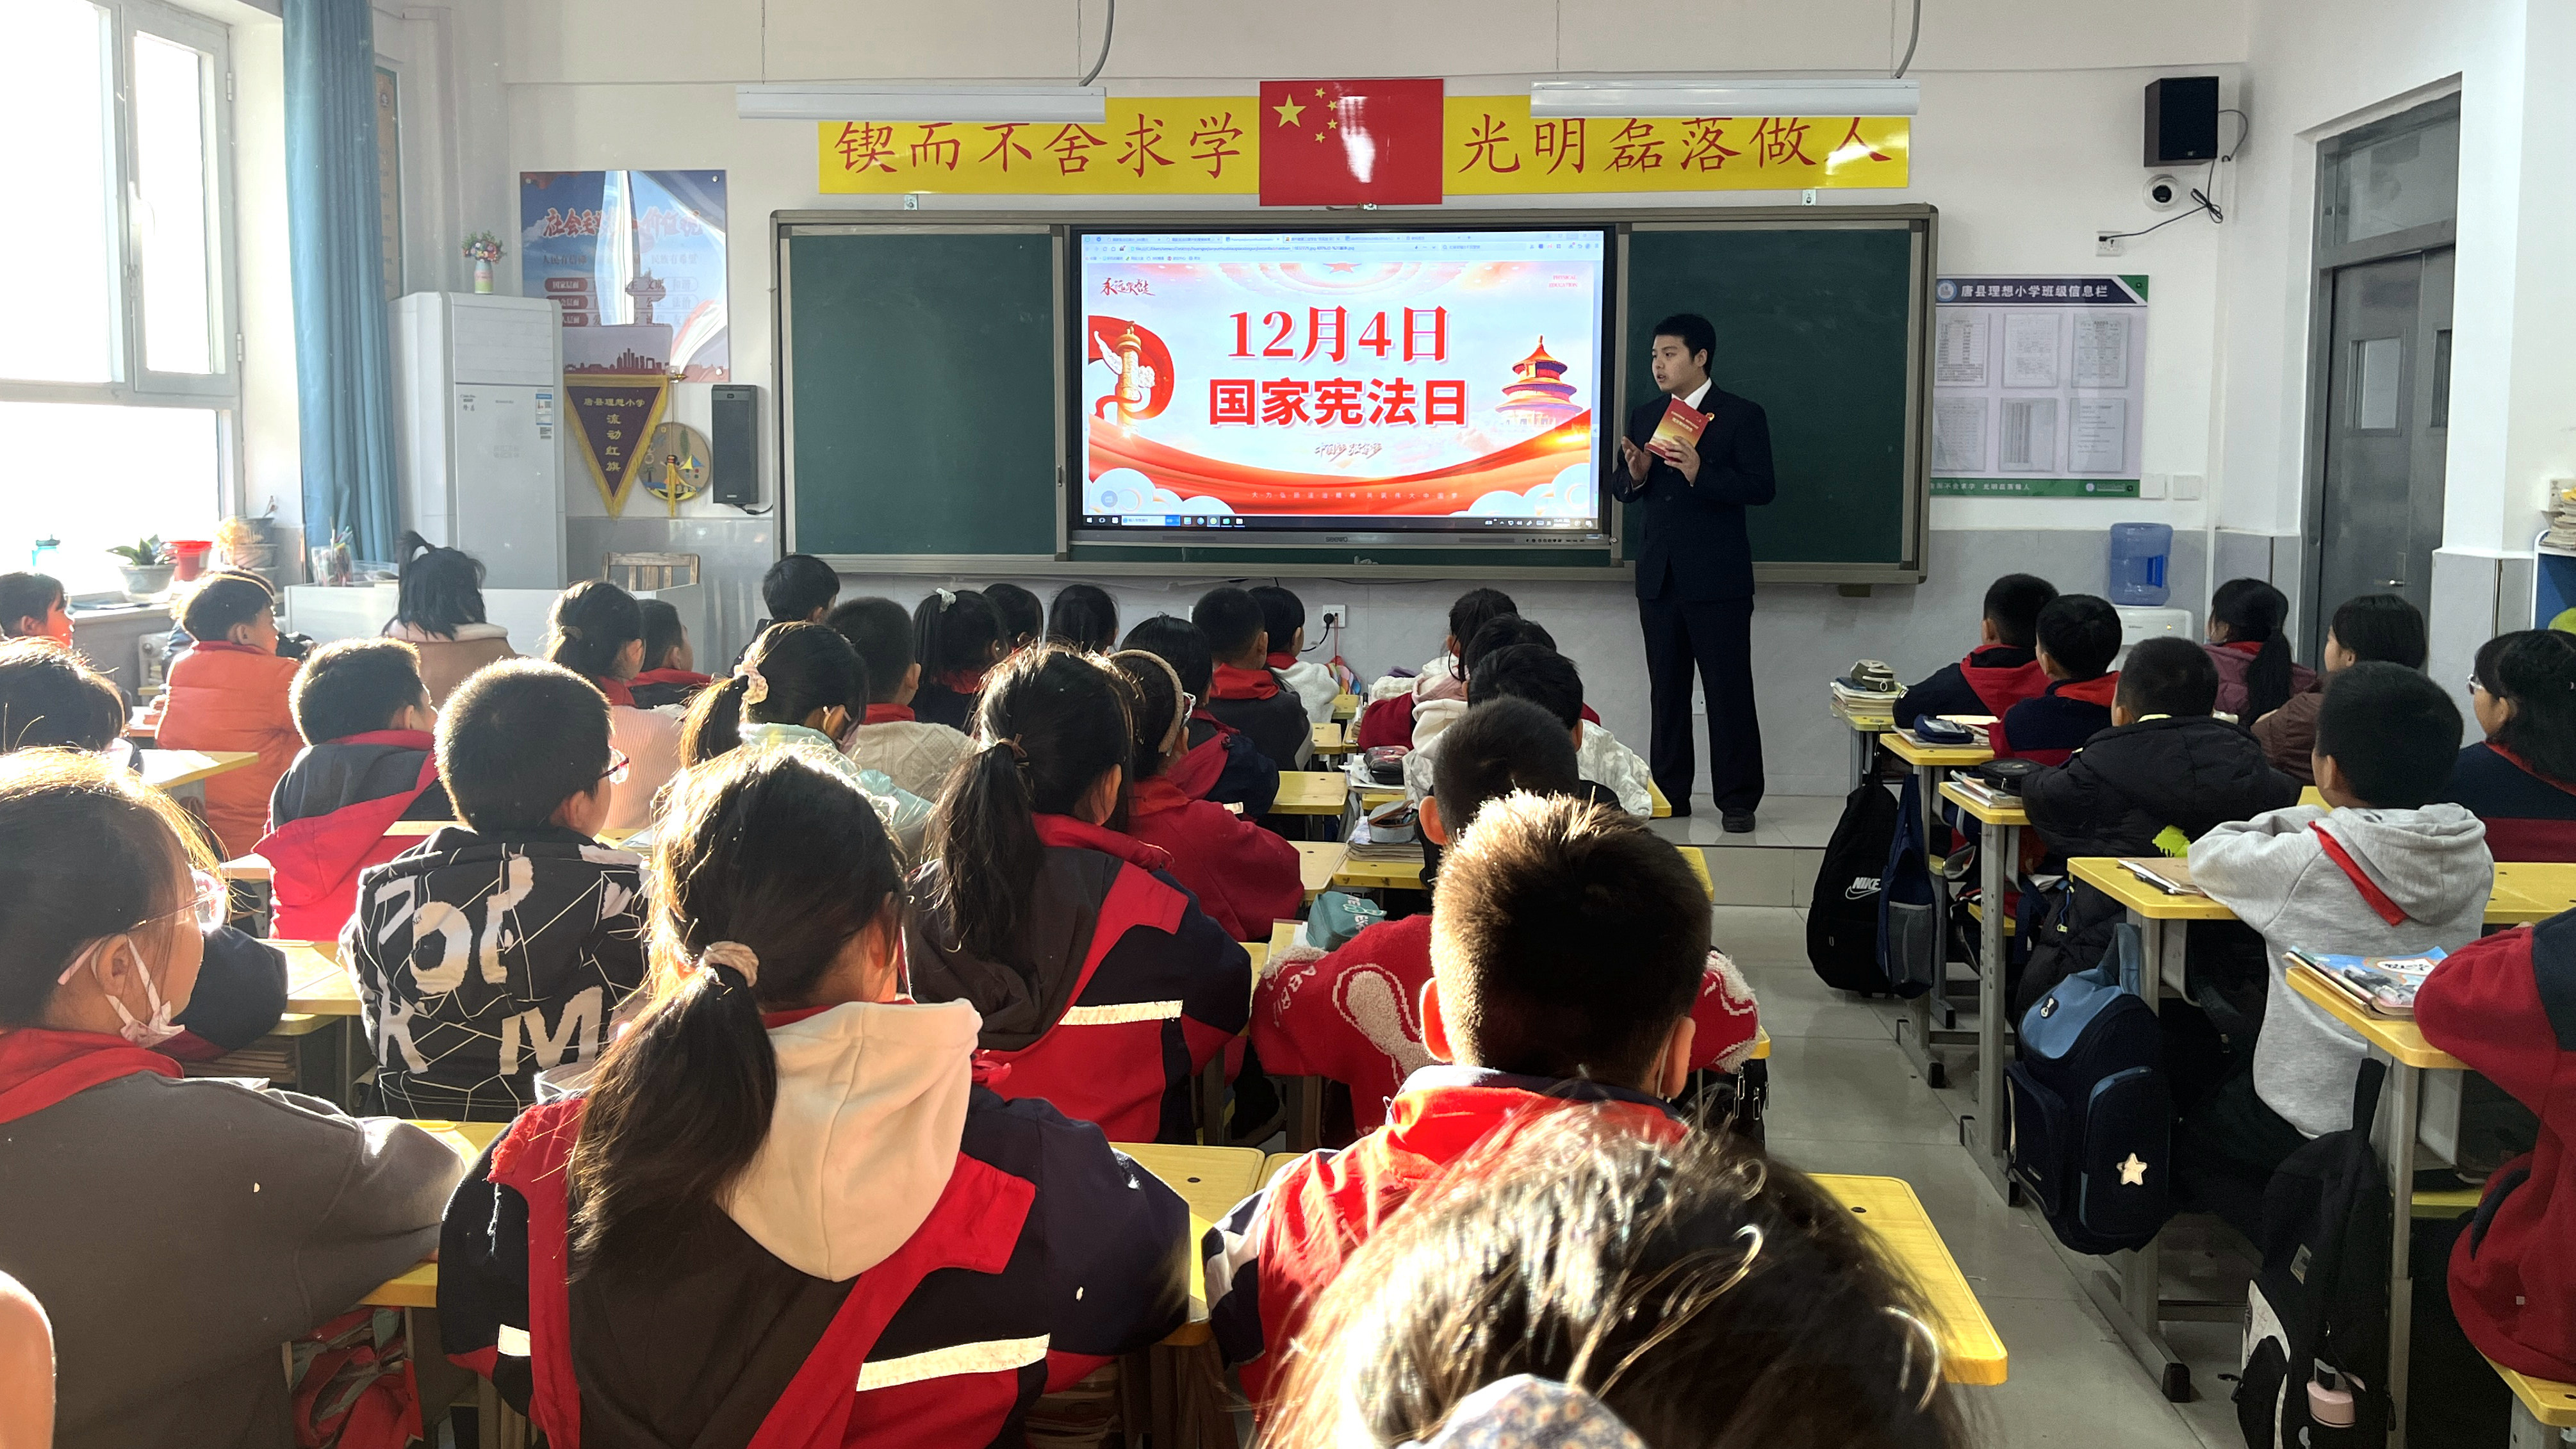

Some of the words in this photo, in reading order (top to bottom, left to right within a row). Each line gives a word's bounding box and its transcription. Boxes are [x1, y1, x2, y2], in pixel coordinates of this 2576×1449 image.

[835, 112, 1243, 179] 锲而不舍求学
[1458, 113, 1892, 175] 光明磊落做人
[1960, 284, 2108, 298] 唐县理想小学班级信息栏
[1228, 305, 1448, 363] 12月4日
[1210, 377, 1466, 426] 国家宪法日
[605, 413, 622, 472] 流动红旗
[1852, 877, 1882, 890] NIKE
